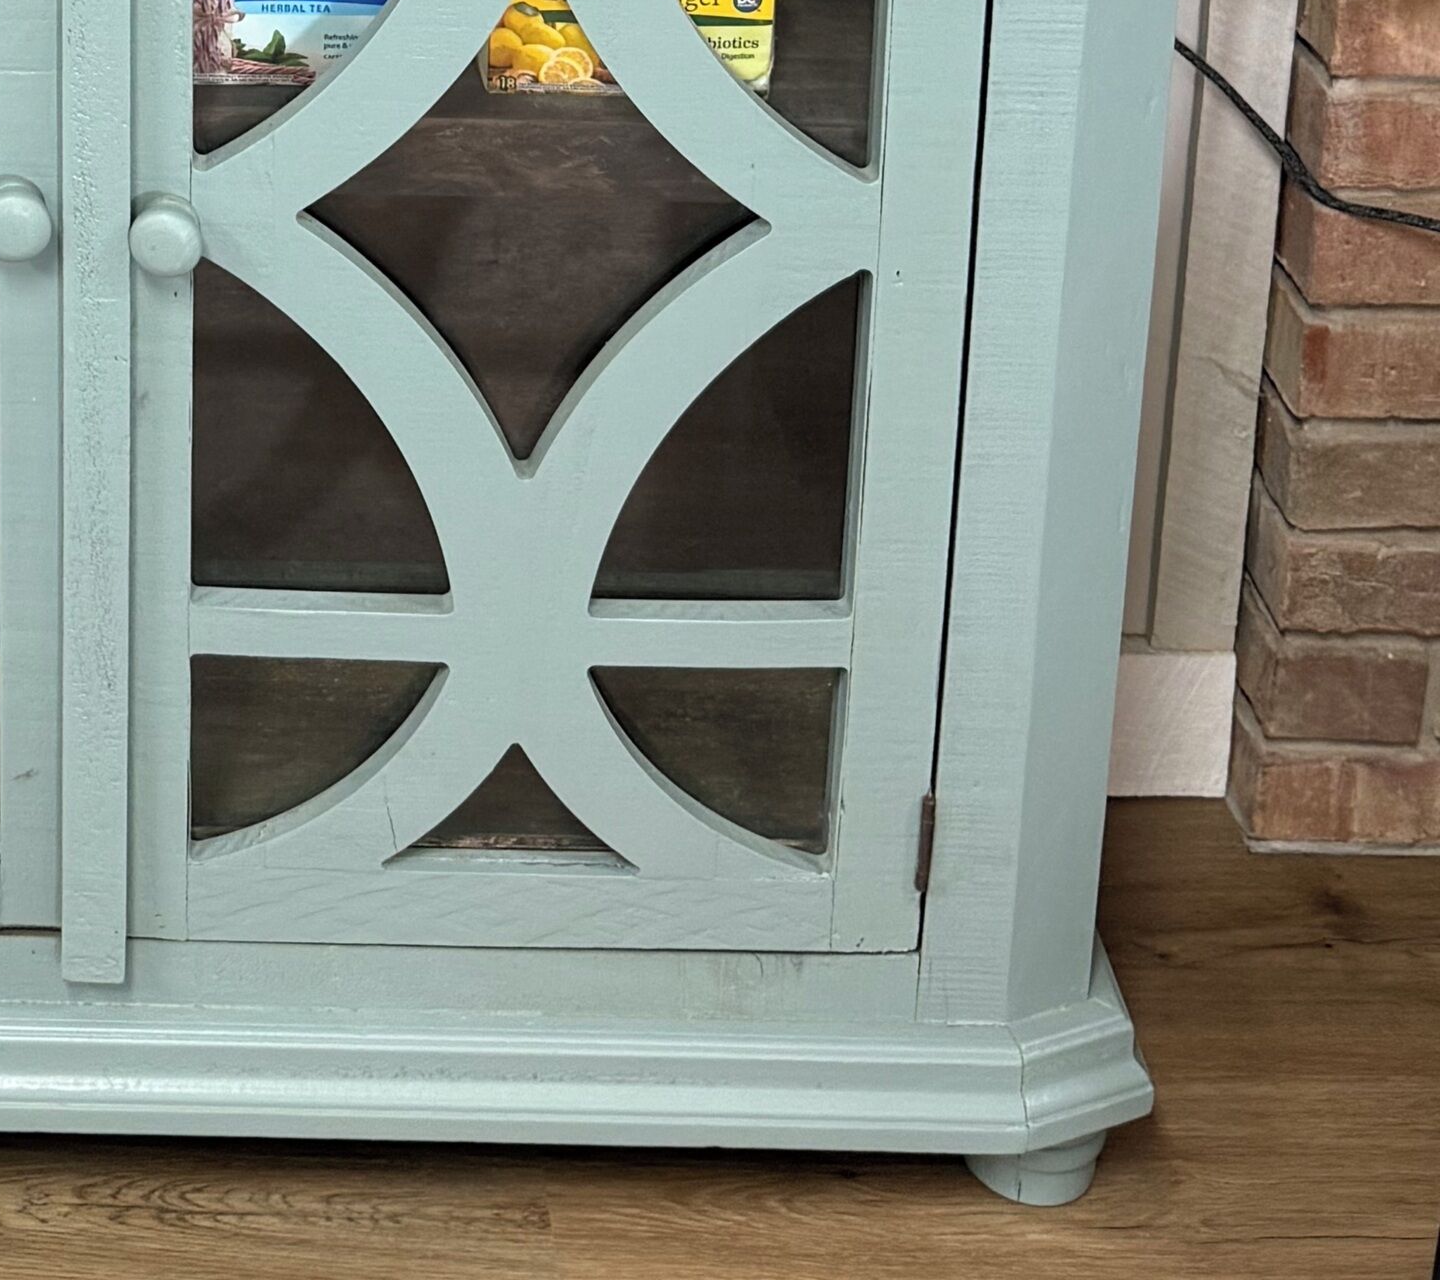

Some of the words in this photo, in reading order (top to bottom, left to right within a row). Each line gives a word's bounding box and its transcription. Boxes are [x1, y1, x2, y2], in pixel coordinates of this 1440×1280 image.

[261, 4, 306, 14] HERBAL
[310, 4, 332, 14] TEA
[707, 36, 760, 49] biotics
[498, 75, 517, 90] 18
